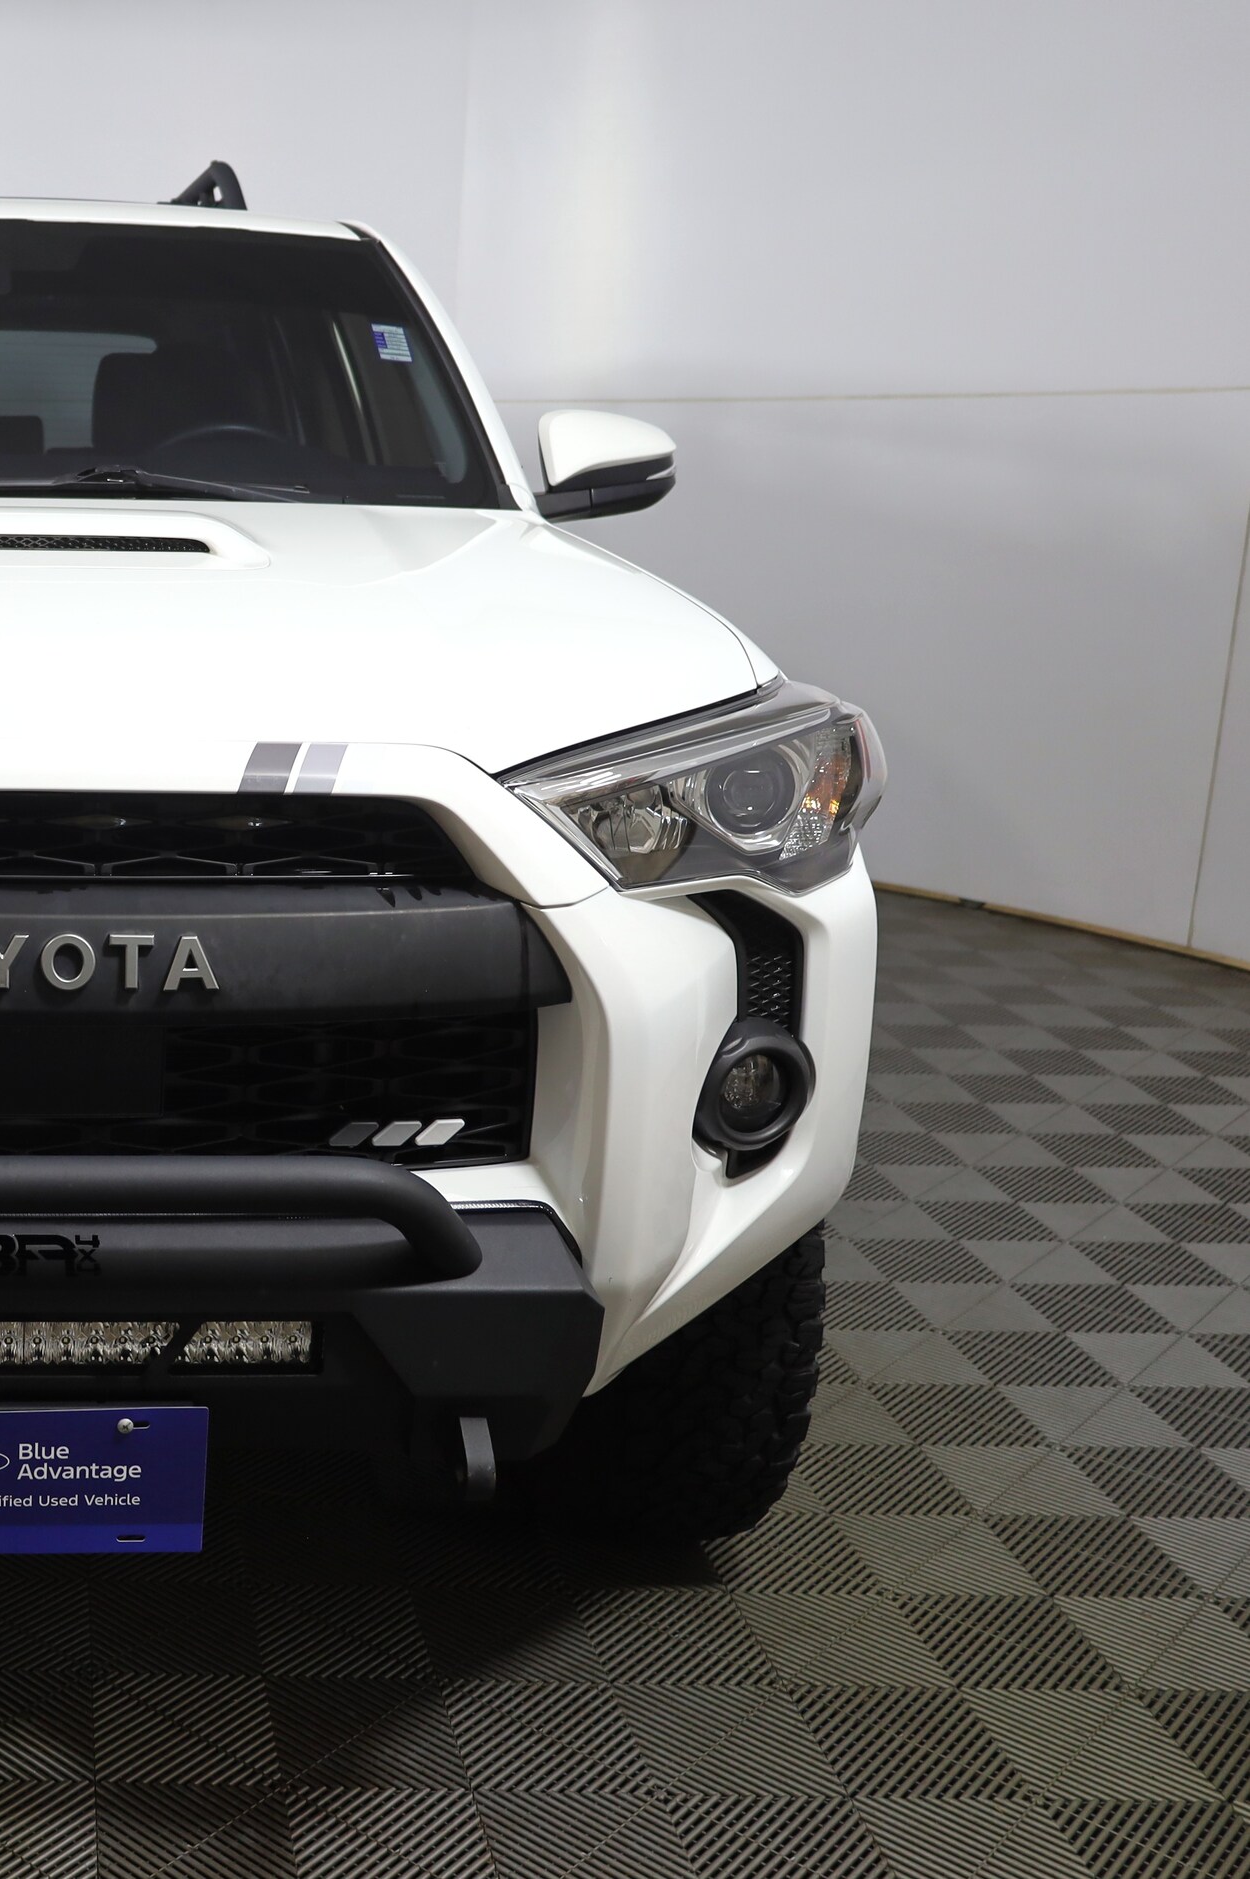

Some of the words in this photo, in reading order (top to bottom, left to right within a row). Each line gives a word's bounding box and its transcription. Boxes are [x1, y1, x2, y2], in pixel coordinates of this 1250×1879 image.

[18, 1443, 70, 1460] Blue
[17, 1463, 142, 1482] Advantage
[38, 1494, 79, 1507] Used
[84, 1493, 141, 1507] Vehicle
